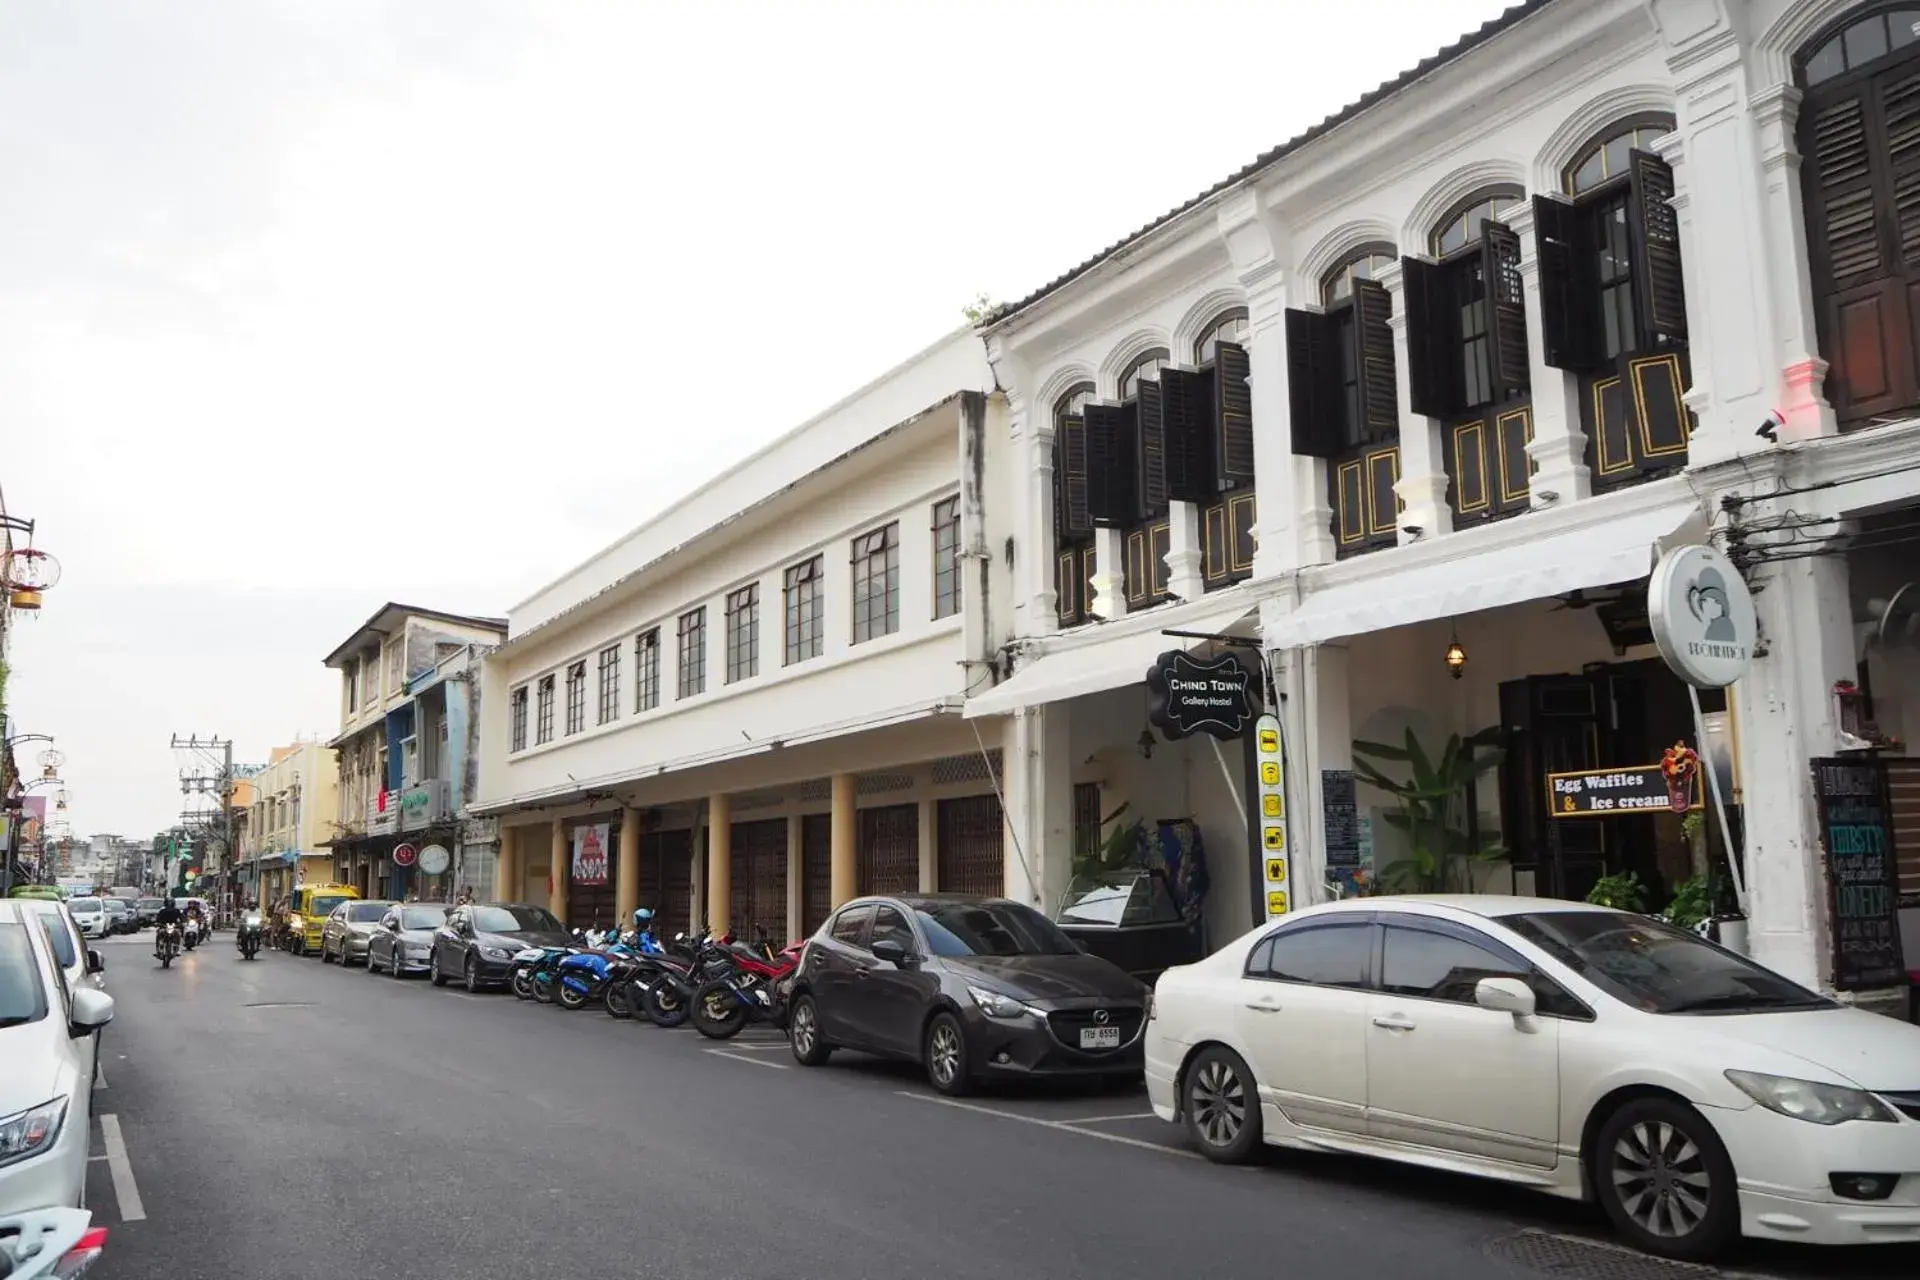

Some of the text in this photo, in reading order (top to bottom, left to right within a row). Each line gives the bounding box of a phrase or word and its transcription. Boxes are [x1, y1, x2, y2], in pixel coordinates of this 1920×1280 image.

[1170, 679, 1242, 691] CHINO TOWN
[1182, 696, 1232, 707] Gallery Hostel
[1555, 774, 1643, 793] Egg Waffles
[1563, 795, 1669, 812] & Ice cream
